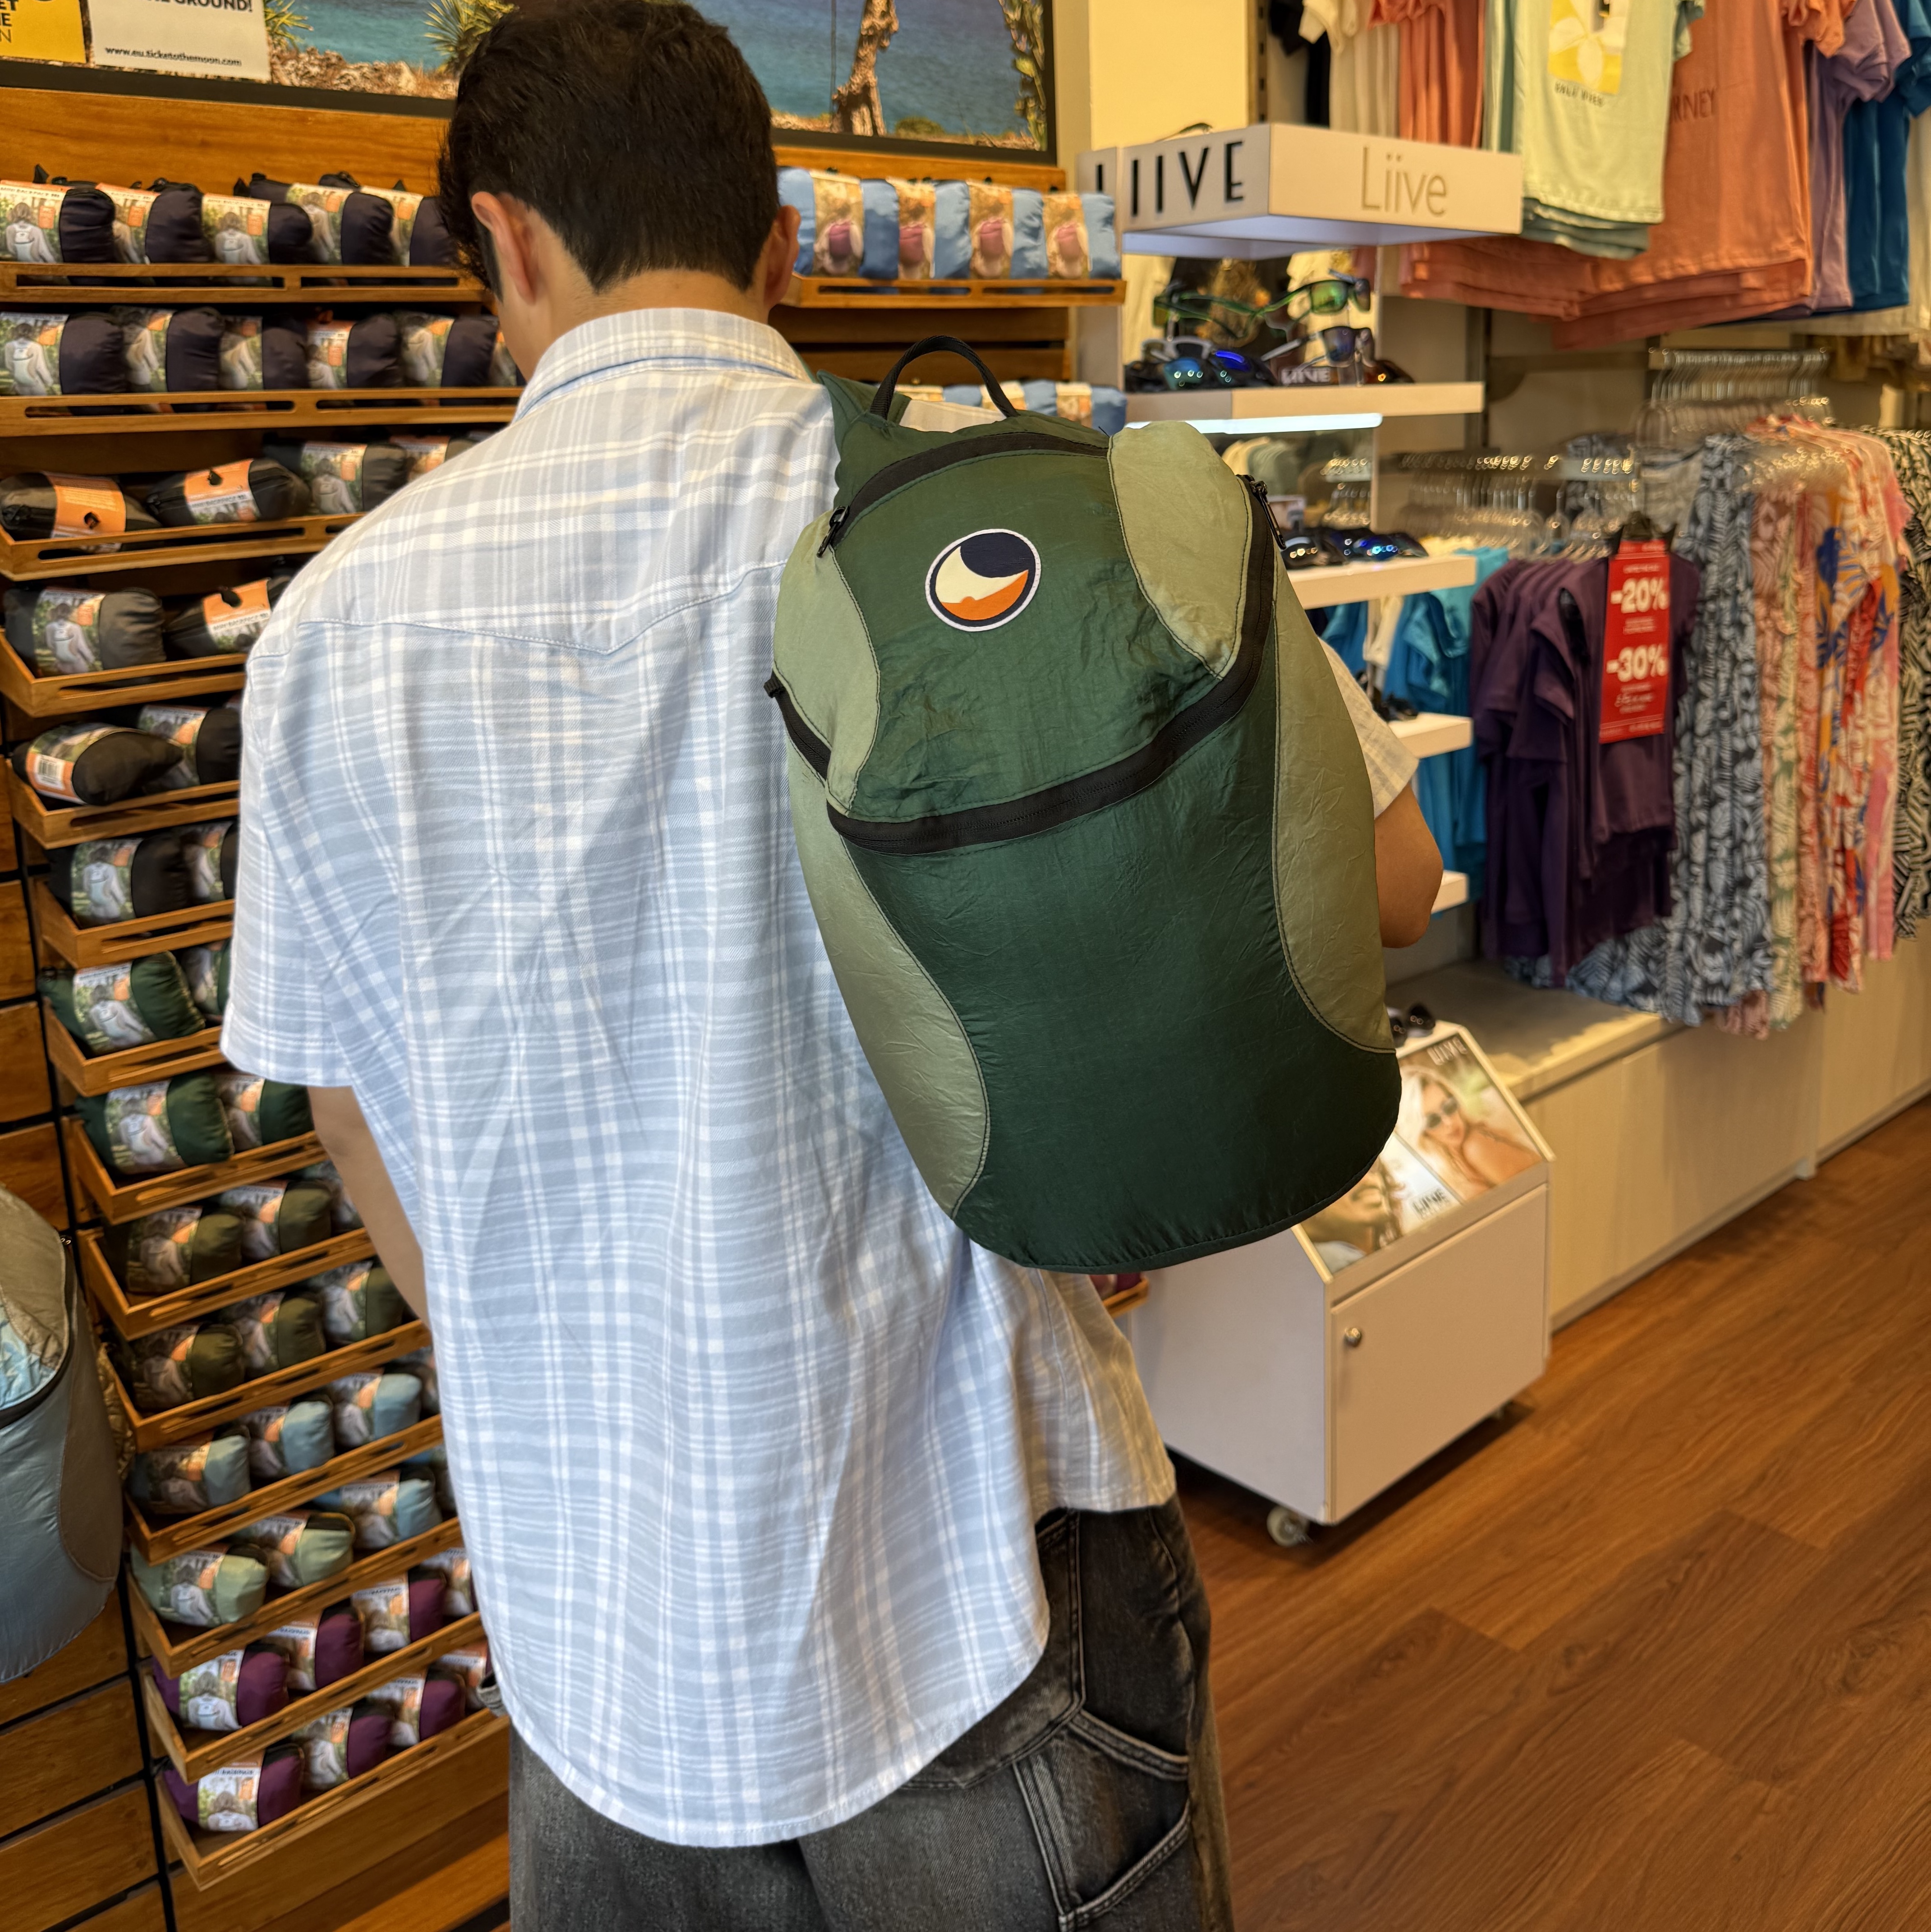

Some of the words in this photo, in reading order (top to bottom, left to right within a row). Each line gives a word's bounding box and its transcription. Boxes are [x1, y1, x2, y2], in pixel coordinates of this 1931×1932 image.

[1362, 147, 1447, 217] Liive
[1610, 578, 1670, 614] -20%
[1606, 644, 1669, 682] -30%
